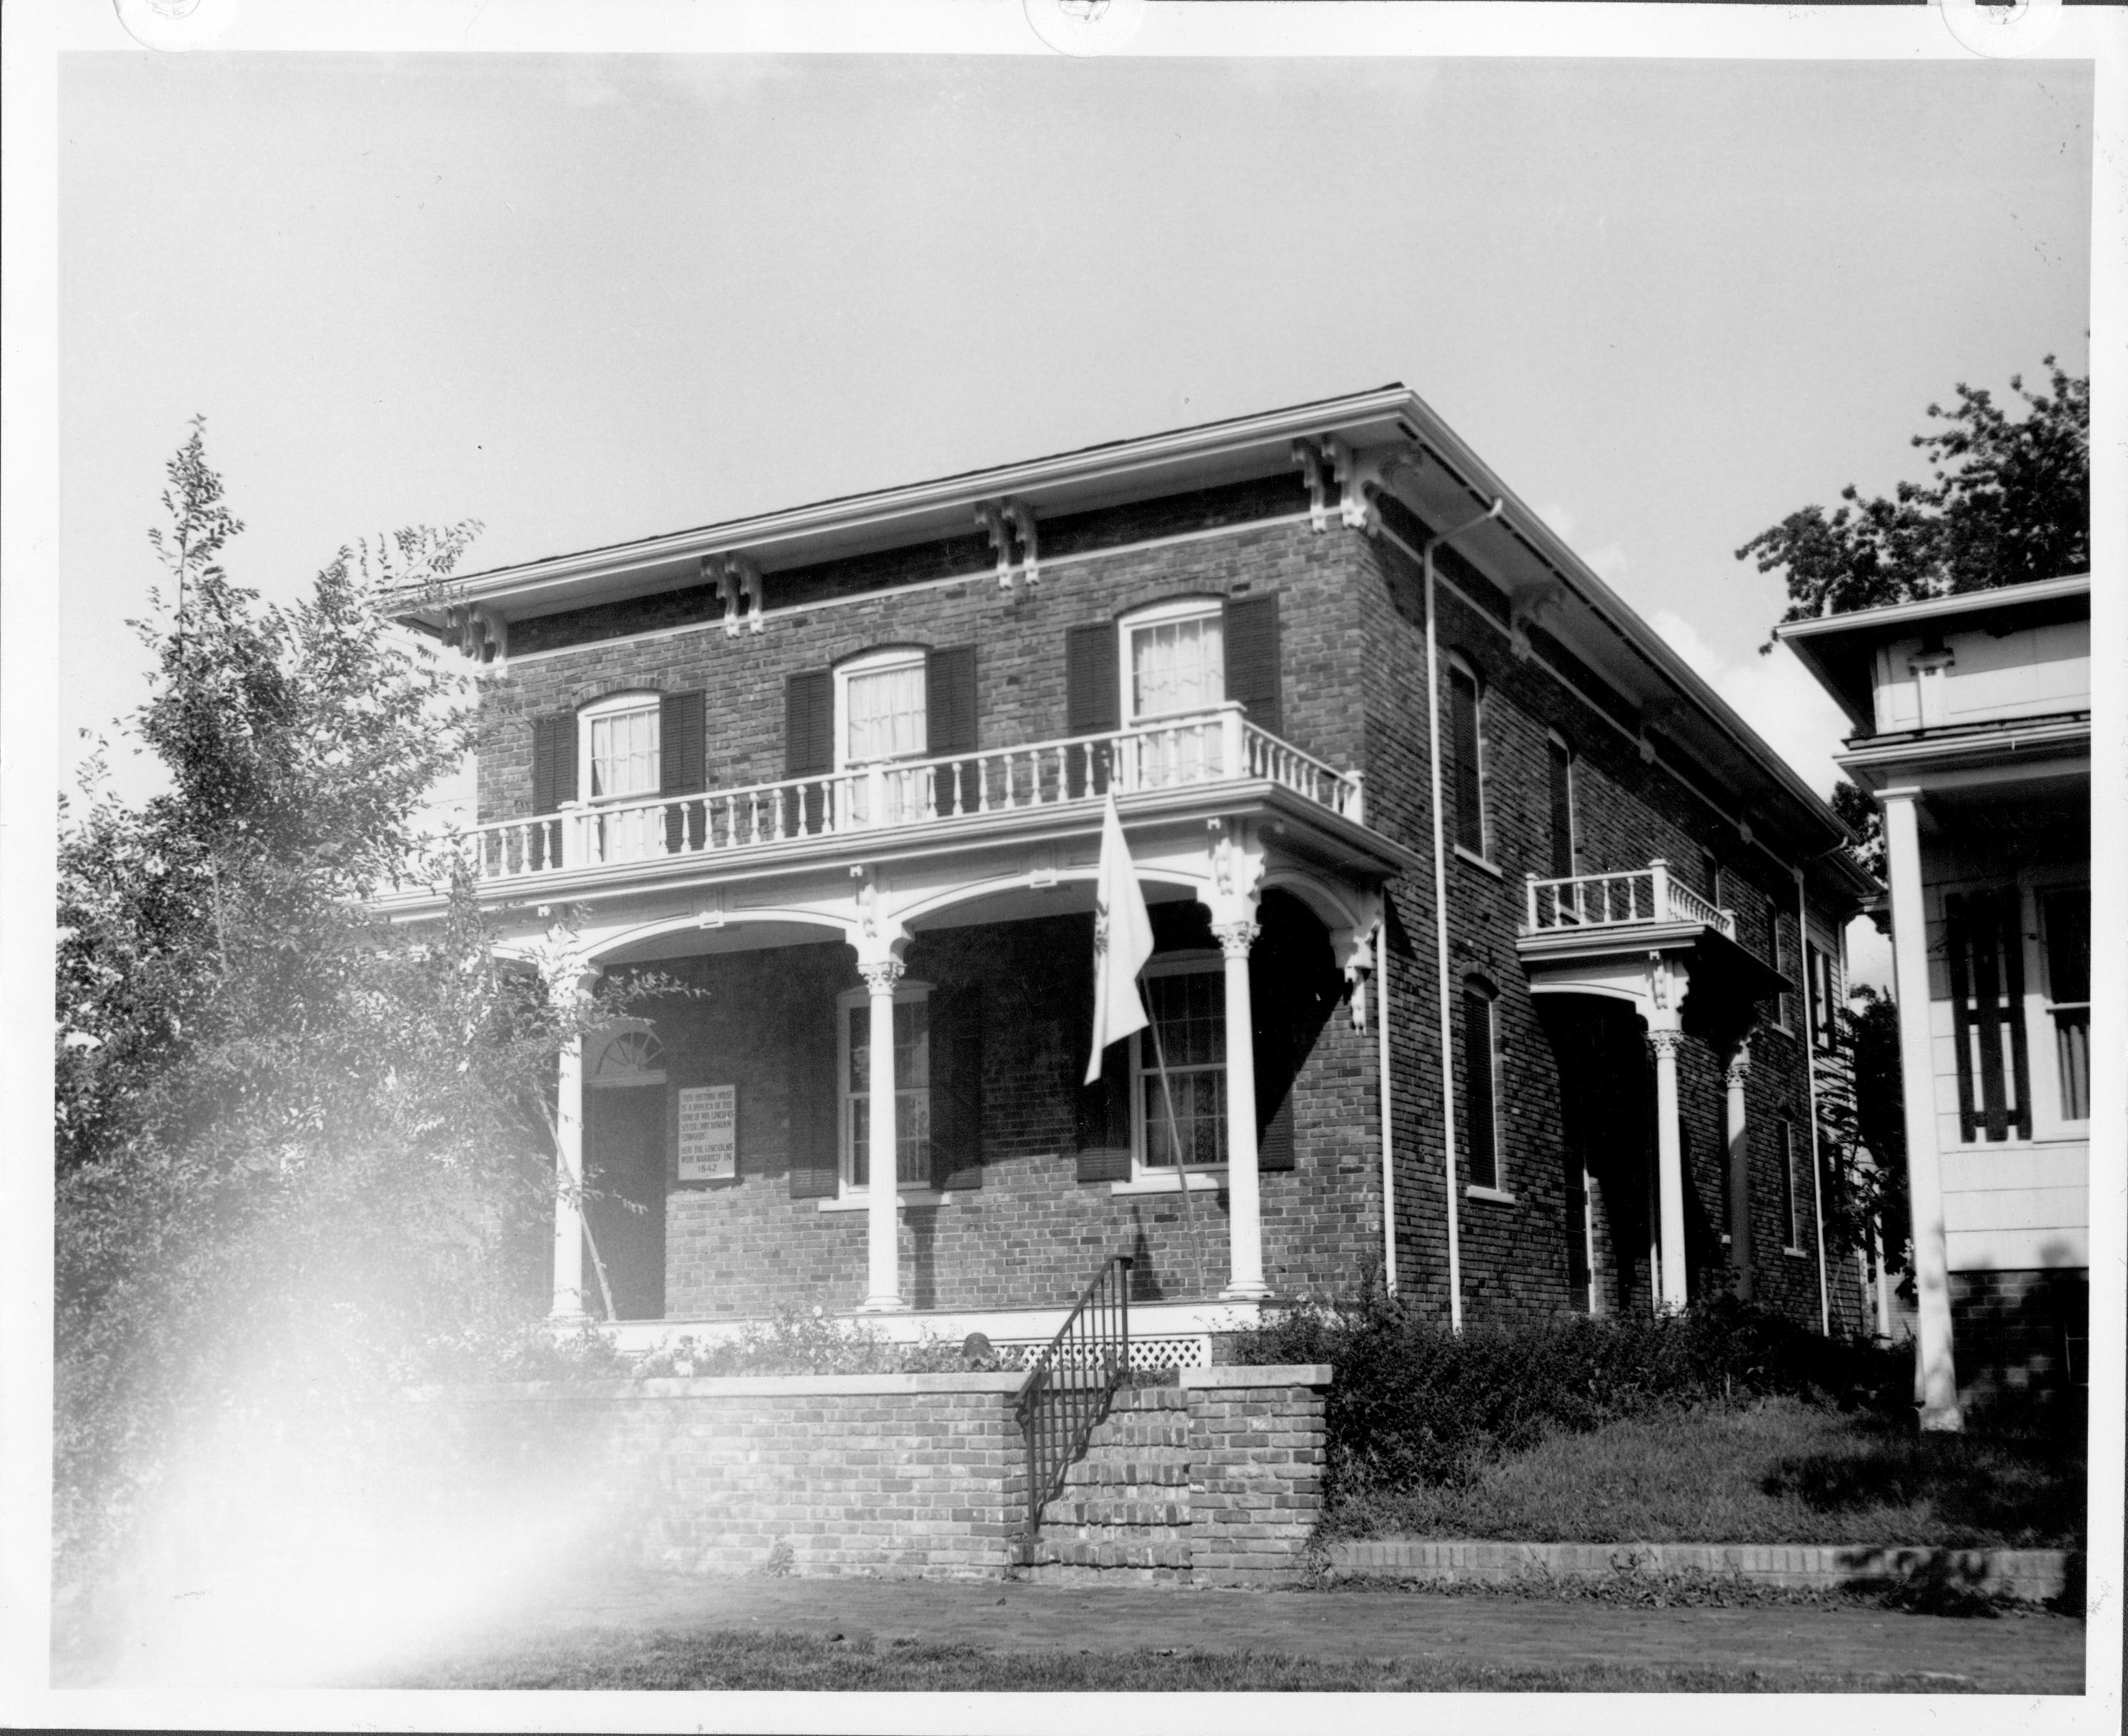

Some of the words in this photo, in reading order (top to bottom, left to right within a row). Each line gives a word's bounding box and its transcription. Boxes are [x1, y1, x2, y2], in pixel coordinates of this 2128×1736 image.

[711, 1120, 732, 1129] NINIAN
[705, 1143, 734, 1152] LINCOLNS
[696, 1154, 721, 1162] MARRIED
